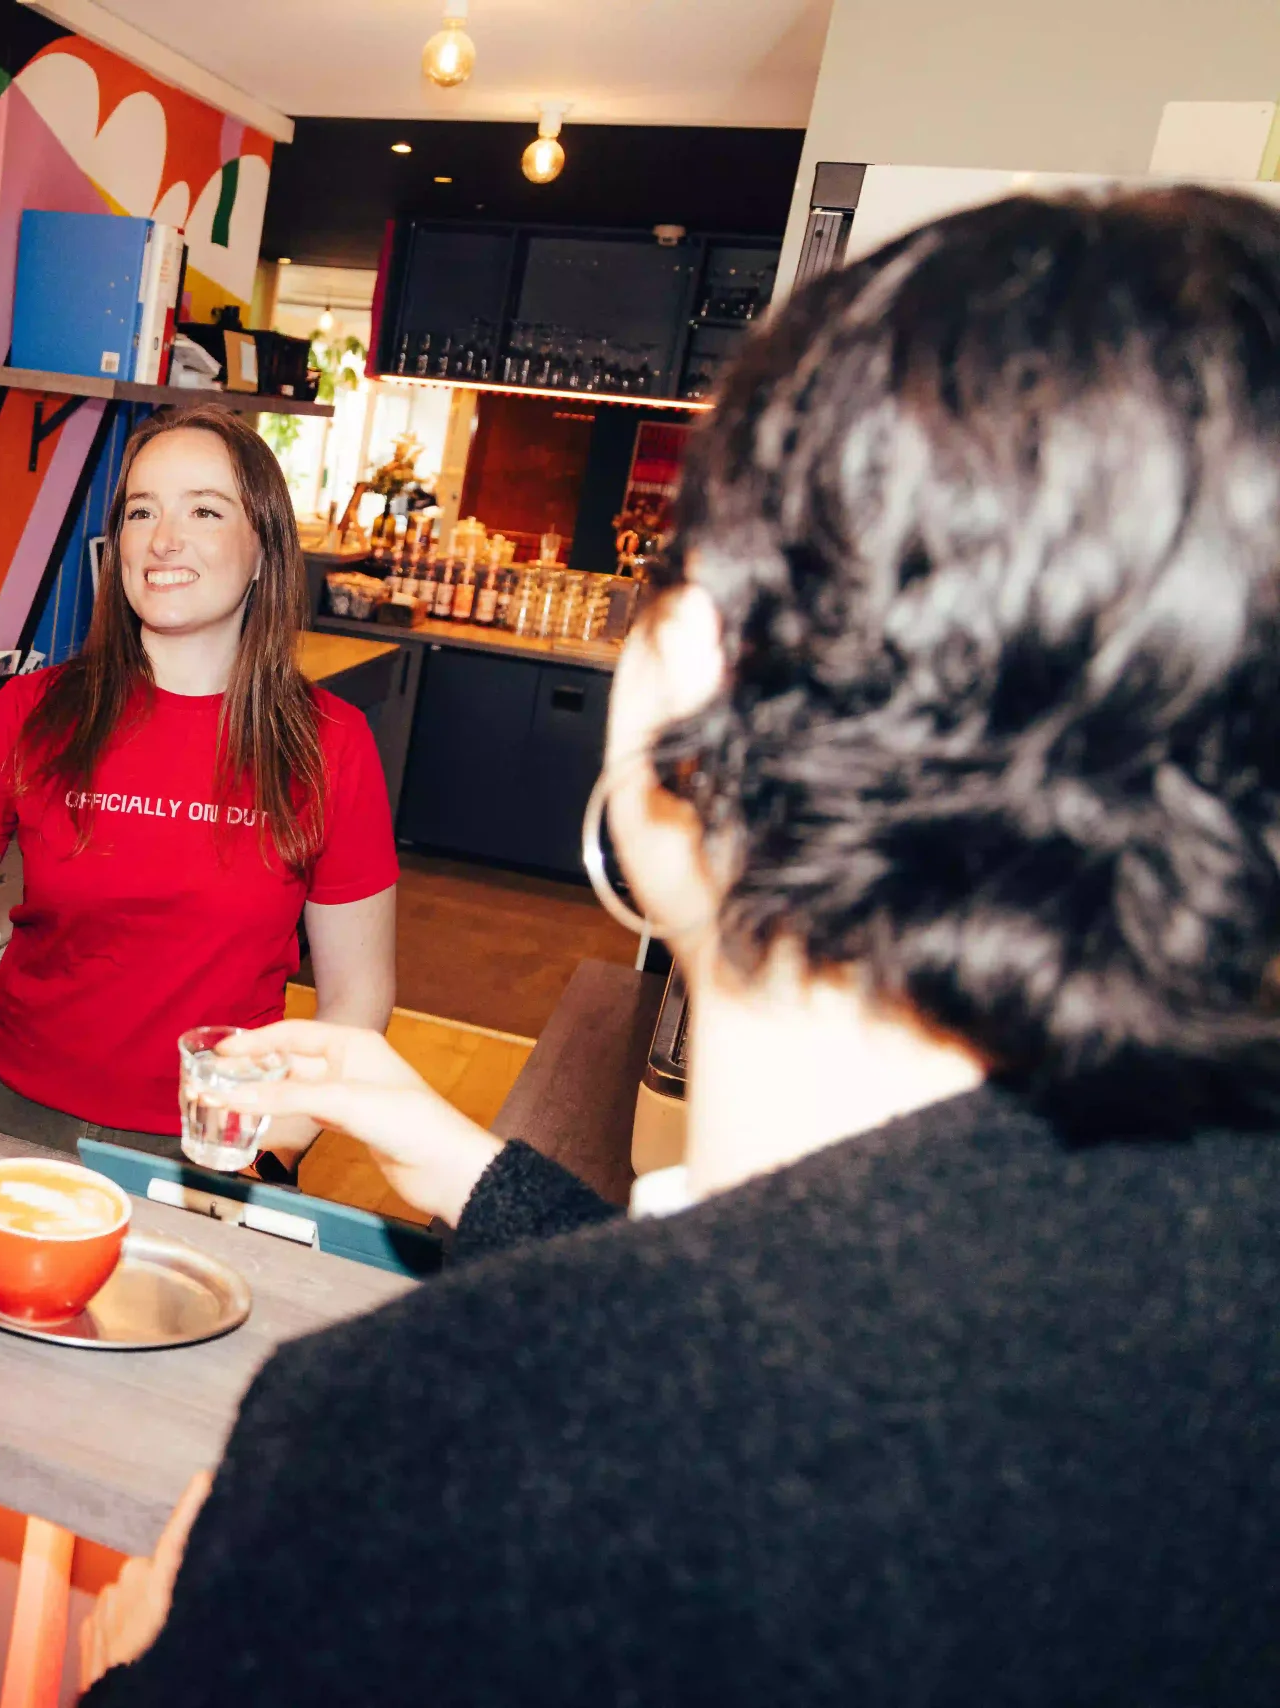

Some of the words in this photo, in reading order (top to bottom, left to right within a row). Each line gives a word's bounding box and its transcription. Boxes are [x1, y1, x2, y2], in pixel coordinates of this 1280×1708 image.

[65, 790, 183, 818] OFFICIALLY
[188, 801, 219, 823] ON
[226, 806, 269, 828] DUT
